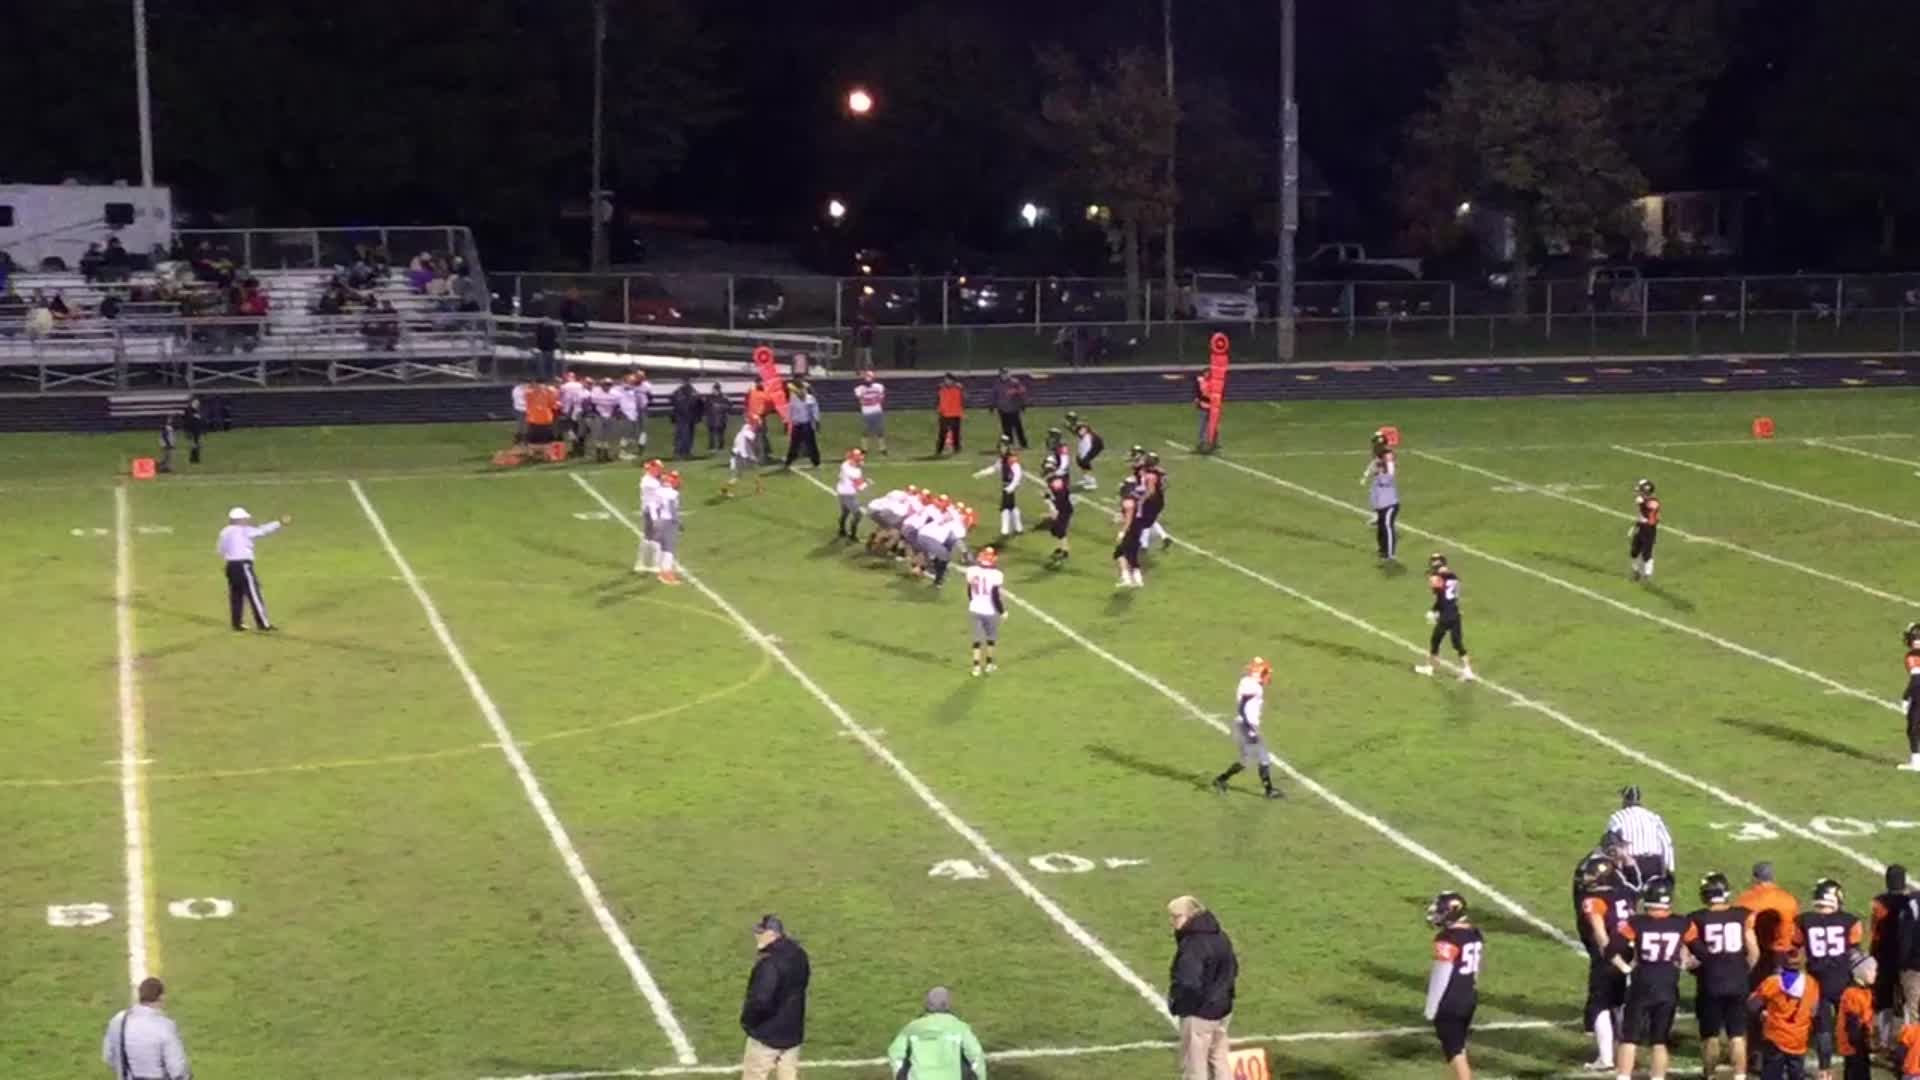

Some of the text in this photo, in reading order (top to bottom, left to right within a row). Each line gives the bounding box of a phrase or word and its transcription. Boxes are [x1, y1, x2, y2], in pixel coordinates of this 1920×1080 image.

[928, 852, 1097, 880] 40
[1641, 931, 1681, 962] 57
[1704, 922, 1743, 954] 50
[1807, 925, 1846, 957] 65
[1233, 1055, 1263, 1080] 40
